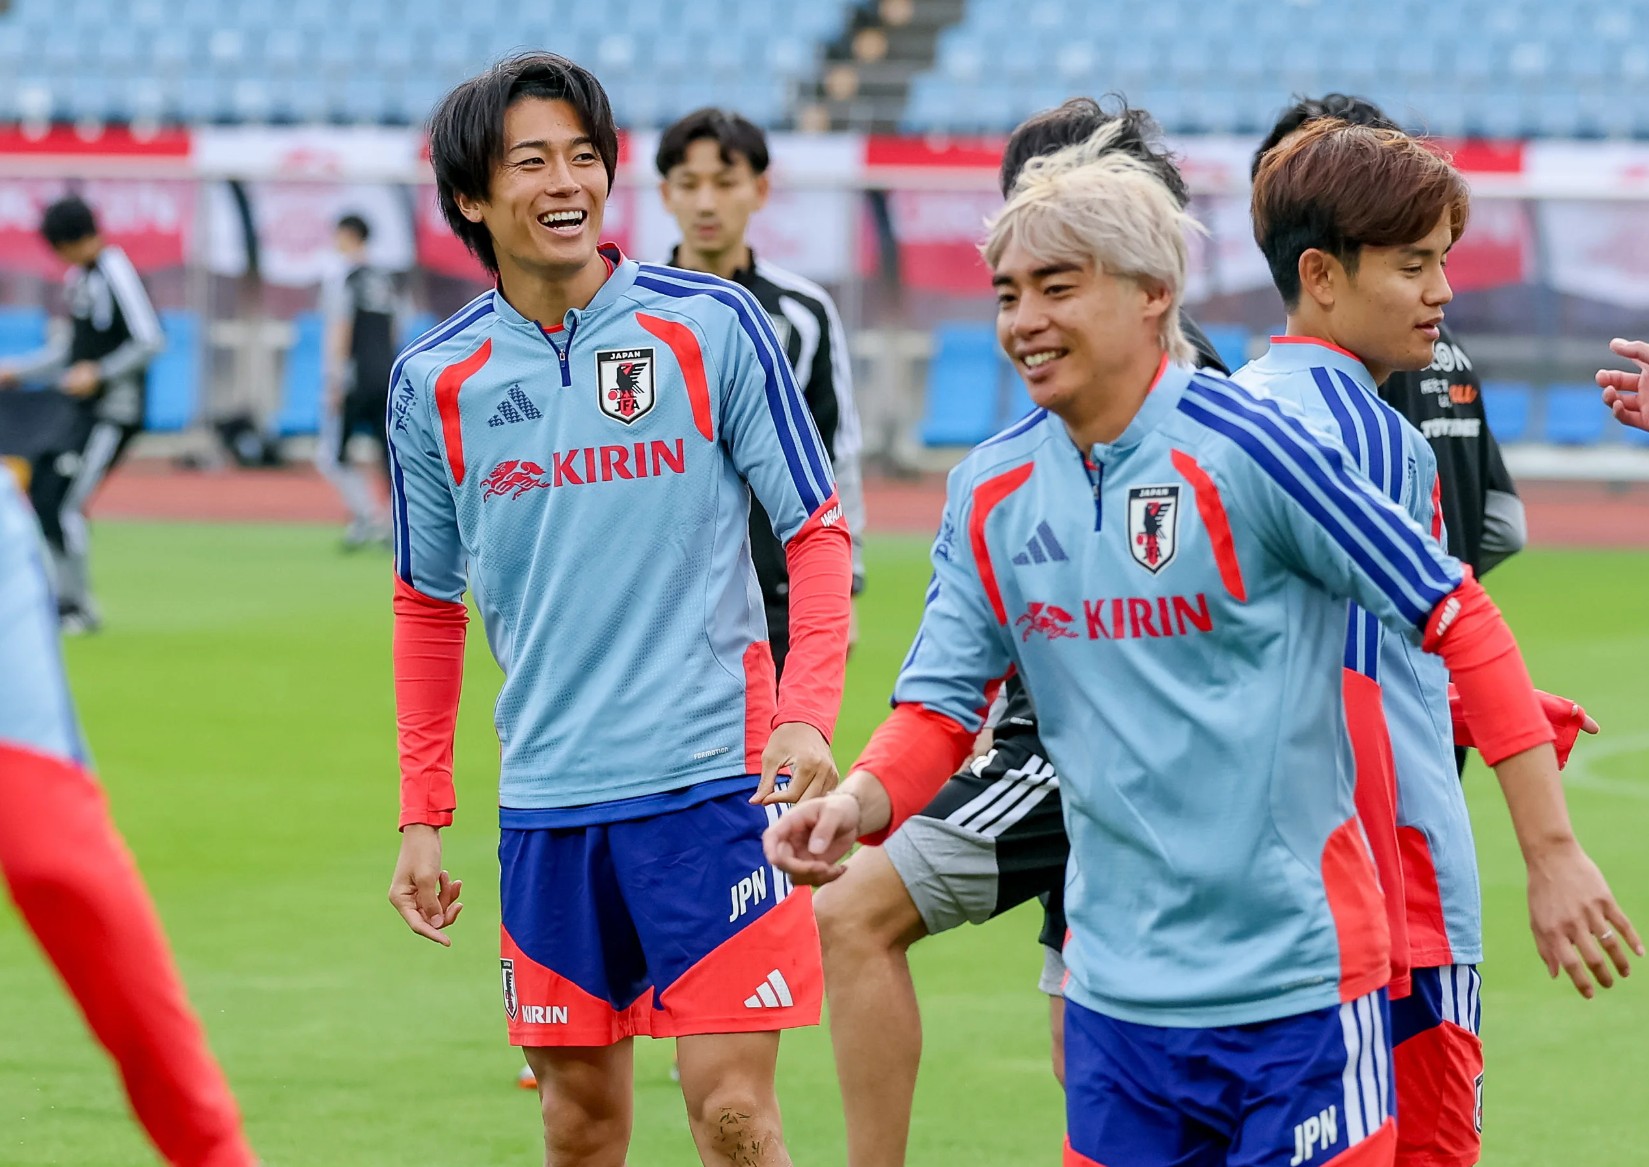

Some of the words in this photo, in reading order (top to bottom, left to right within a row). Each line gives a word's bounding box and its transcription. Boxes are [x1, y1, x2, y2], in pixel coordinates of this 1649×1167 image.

[610, 351, 641, 360] JAPAN
[614, 399, 641, 412] JFA
[553, 438, 685, 488] KIRIN
[1083, 593, 1213, 641] KIRIN
[729, 865, 767, 923] JPN
[521, 1005, 568, 1024] KIRIN
[1290, 1104, 1337, 1167] JPN
